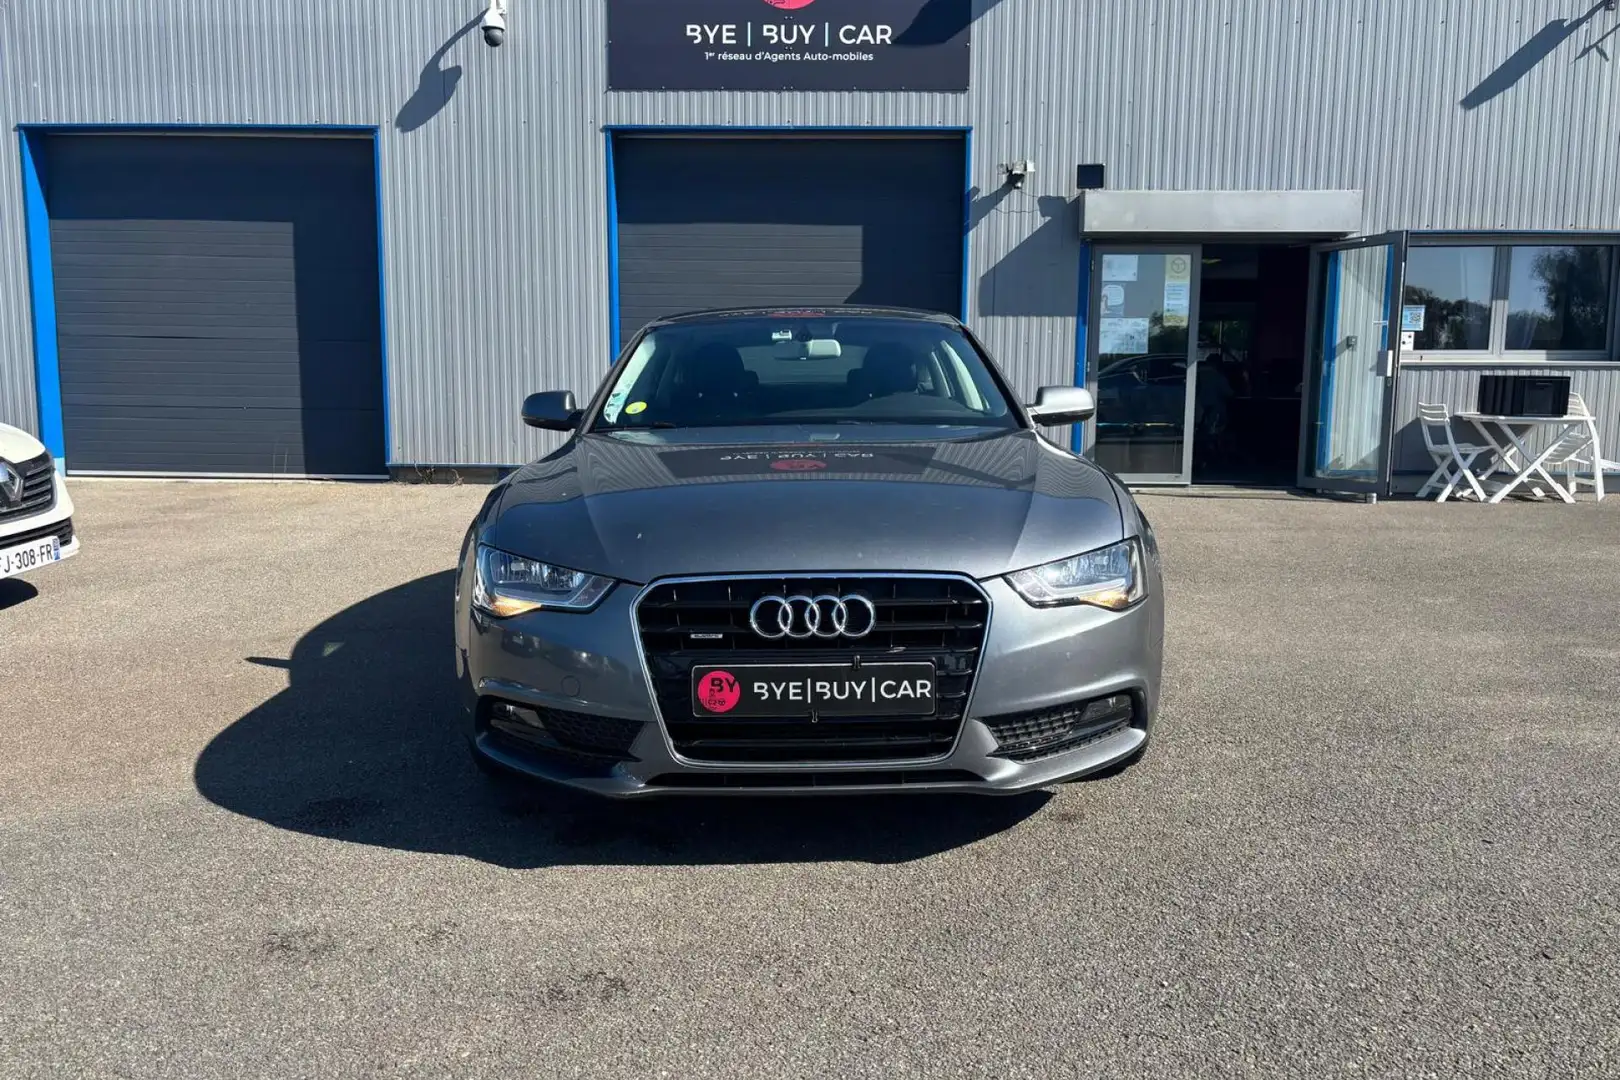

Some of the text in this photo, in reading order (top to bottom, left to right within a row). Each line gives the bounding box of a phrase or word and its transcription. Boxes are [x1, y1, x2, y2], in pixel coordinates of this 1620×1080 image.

[686, 24, 892, 45] BYE BUY CAR
[717, 52, 752, 61] réseau
[803, 51, 874, 61] Auto-mobiles
